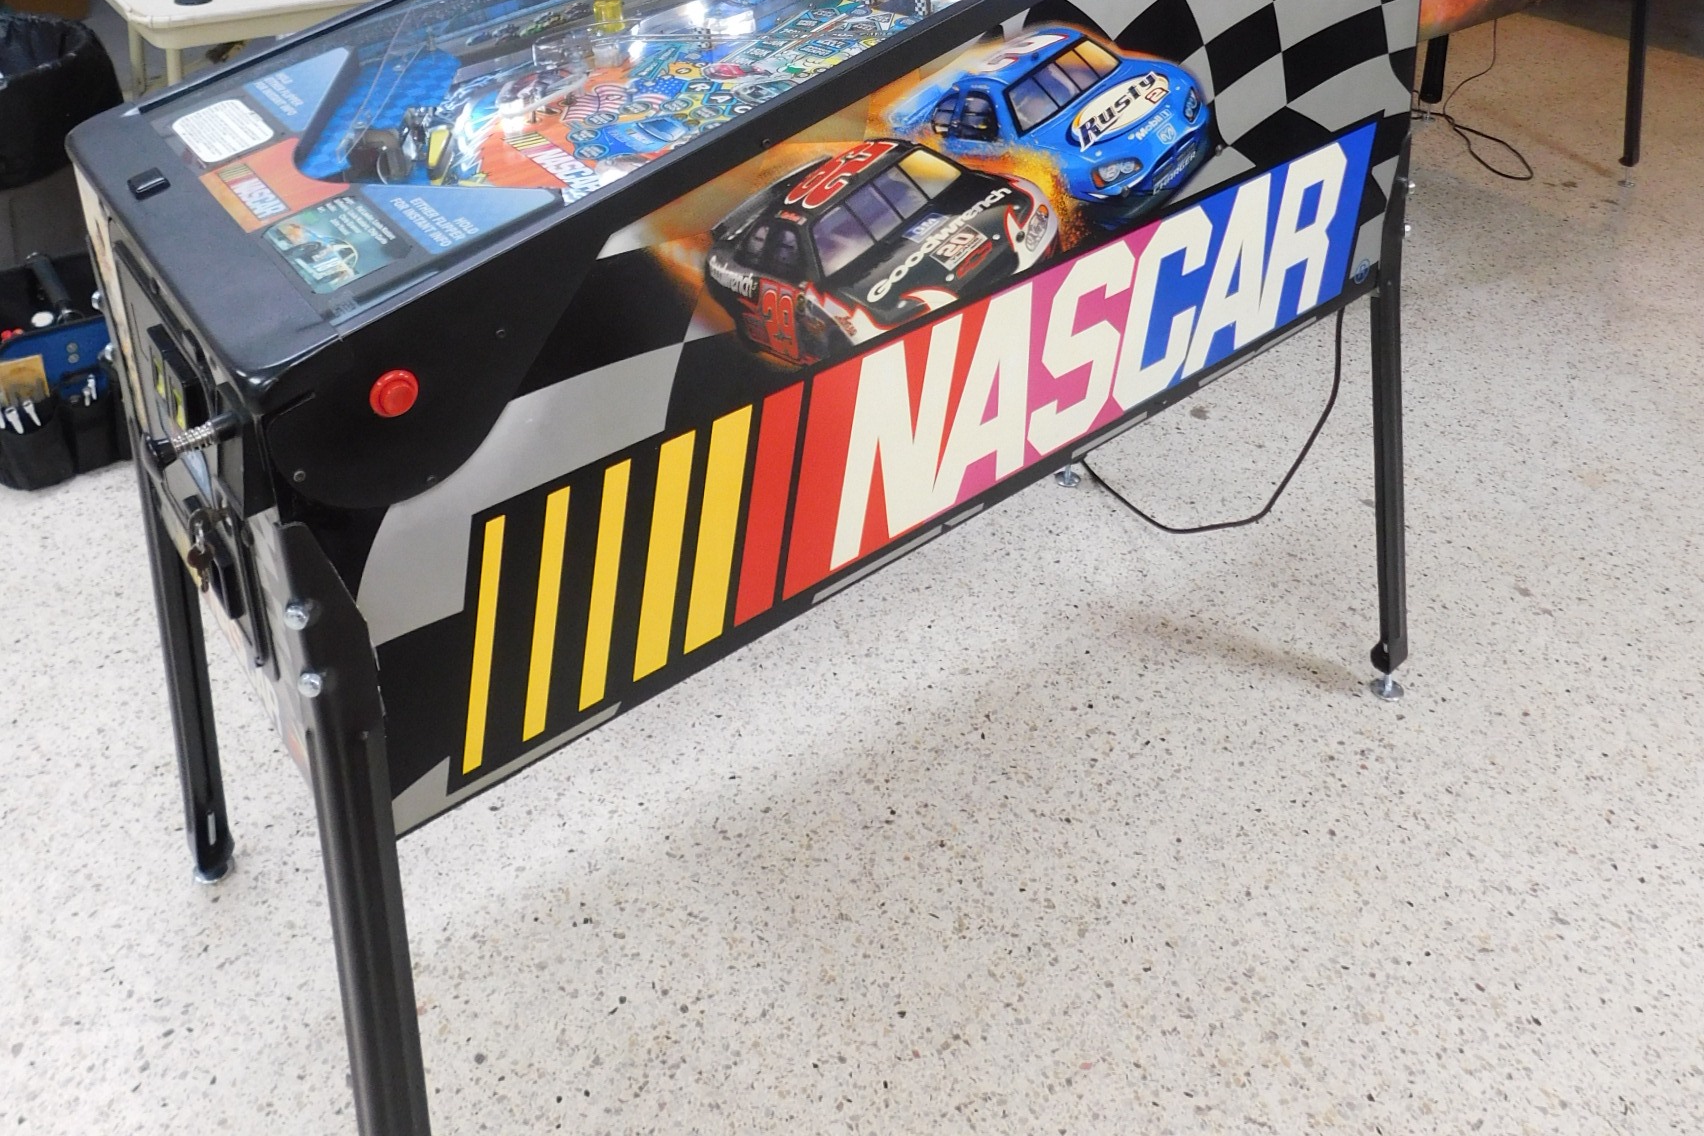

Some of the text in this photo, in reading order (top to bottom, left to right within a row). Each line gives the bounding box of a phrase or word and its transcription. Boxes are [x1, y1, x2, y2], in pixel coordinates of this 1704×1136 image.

[1079, 71, 1157, 152] Rusty
[1145, 87, 1170, 104] 2
[1135, 116, 1162, 141] Mobil
[1153, 151, 1196, 195] CHARGER
[229, 177, 288, 219] NASCAR
[409, 197, 440, 219] EITHER
[432, 216, 466, 241] FLIPPER
[390, 197, 452, 247] FOR INSTANT INFO
[453, 217, 479, 235] HOLD
[912, 217, 939, 237] GM
[936, 230, 976, 258] 20
[866, 186, 1012, 303] Goodwrench
[761, 288, 800, 359] 29
[830, 142, 1348, 572] NASCAR
